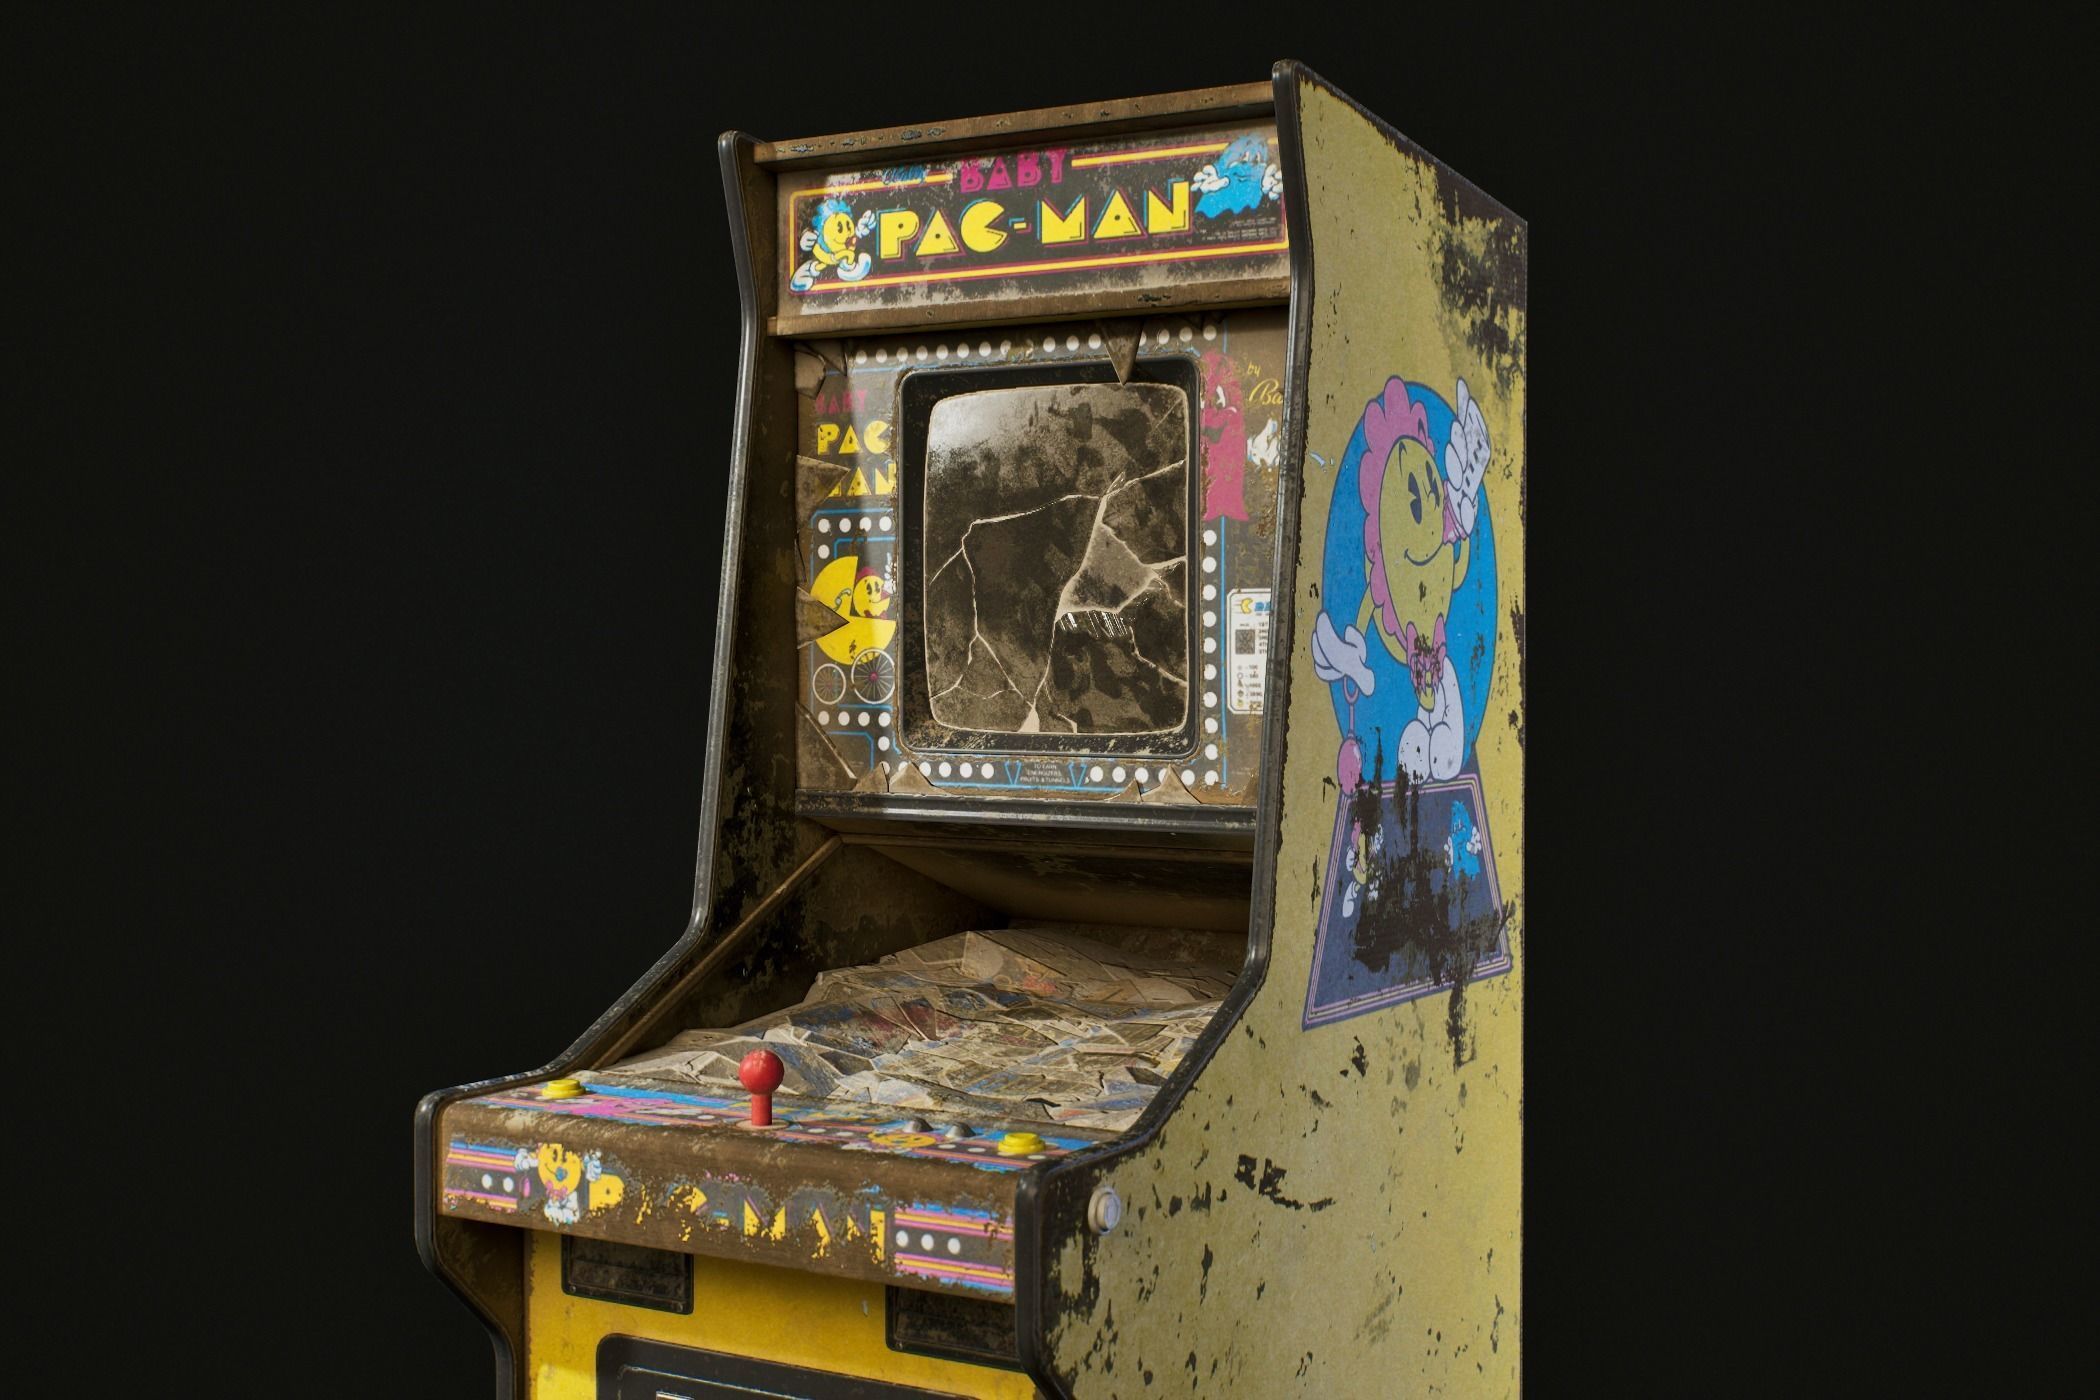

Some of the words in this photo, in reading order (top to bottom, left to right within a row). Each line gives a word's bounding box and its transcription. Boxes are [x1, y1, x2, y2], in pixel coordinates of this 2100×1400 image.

[960, 149, 1068, 193] BABY
[877, 179, 1191, 261] PAC-MAN
[1247, 361, 1261, 378] by
[817, 420, 892, 456] PAC
